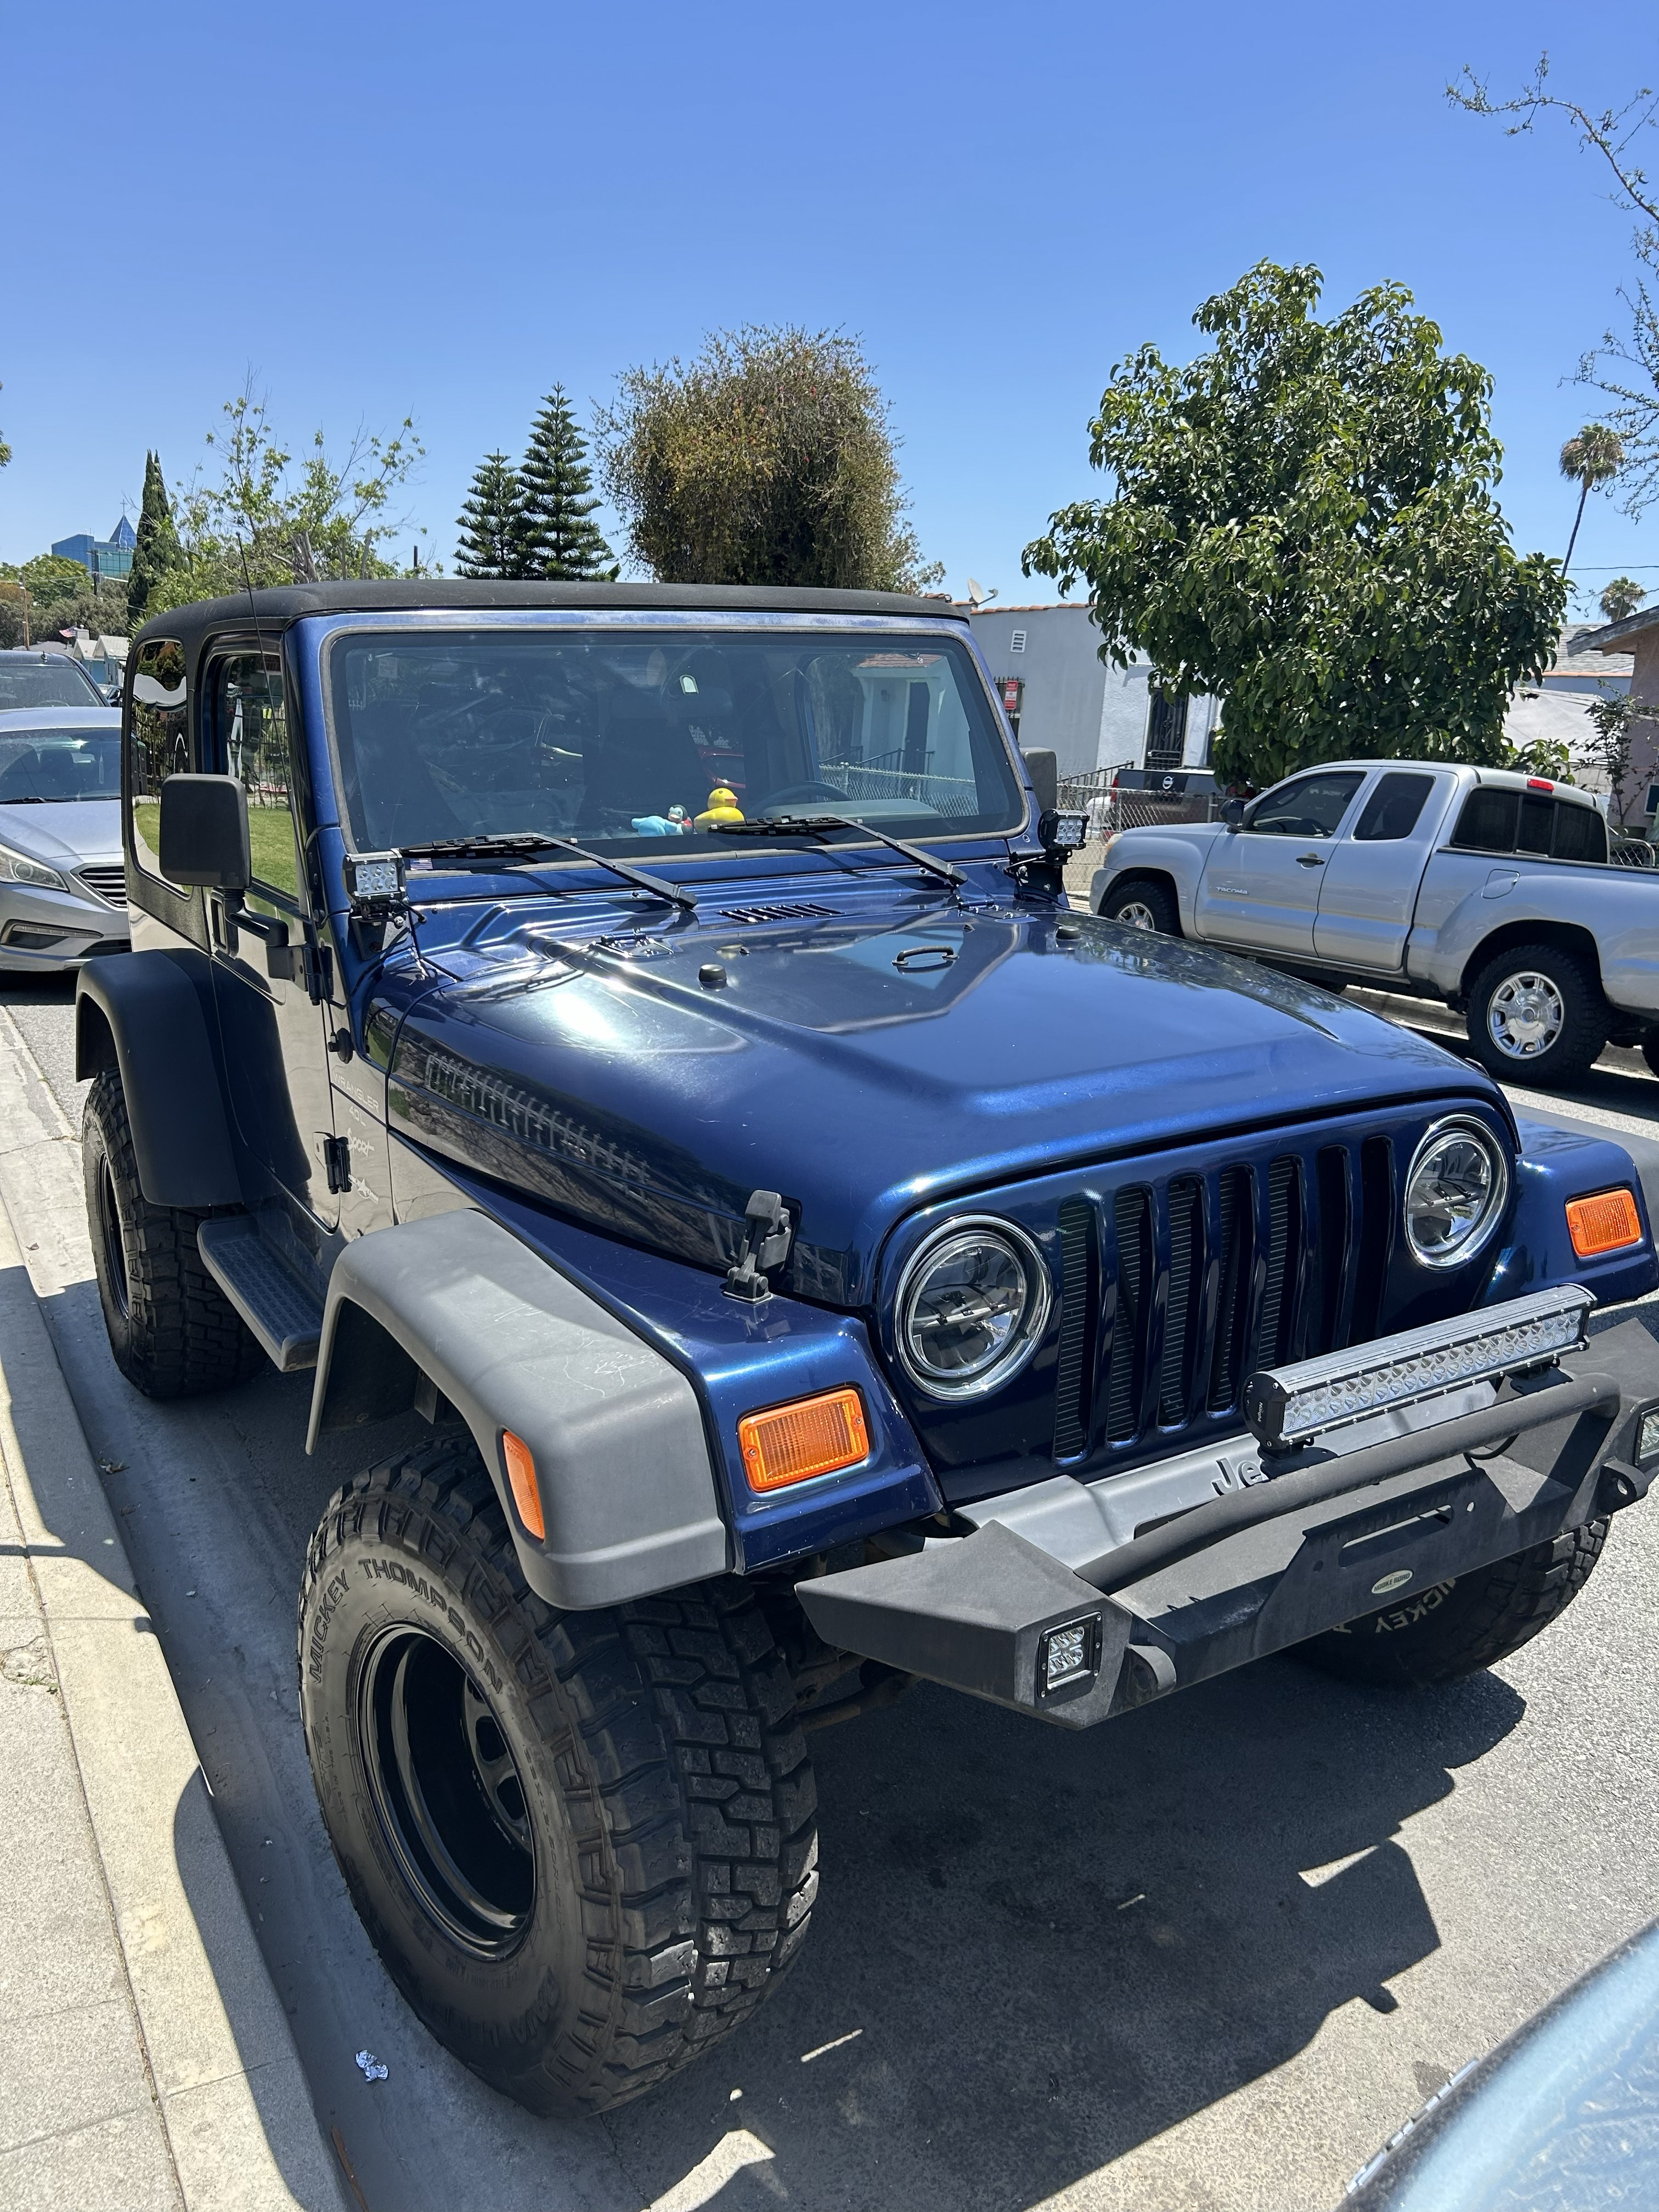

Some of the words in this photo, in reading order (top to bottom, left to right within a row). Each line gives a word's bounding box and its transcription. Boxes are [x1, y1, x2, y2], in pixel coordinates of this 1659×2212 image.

[332, 1070, 379, 1114] WRANGLER
[347, 1127, 375, 1158] Sport
[1211, 1457, 1263, 1496] Je
[1374, 1579, 1393, 1592] HOOKE
[1393, 1572, 1410, 1584] ROAD
[309, 1568, 350, 1684] MICKEY
[358, 1558, 503, 1695] THOMPSON
